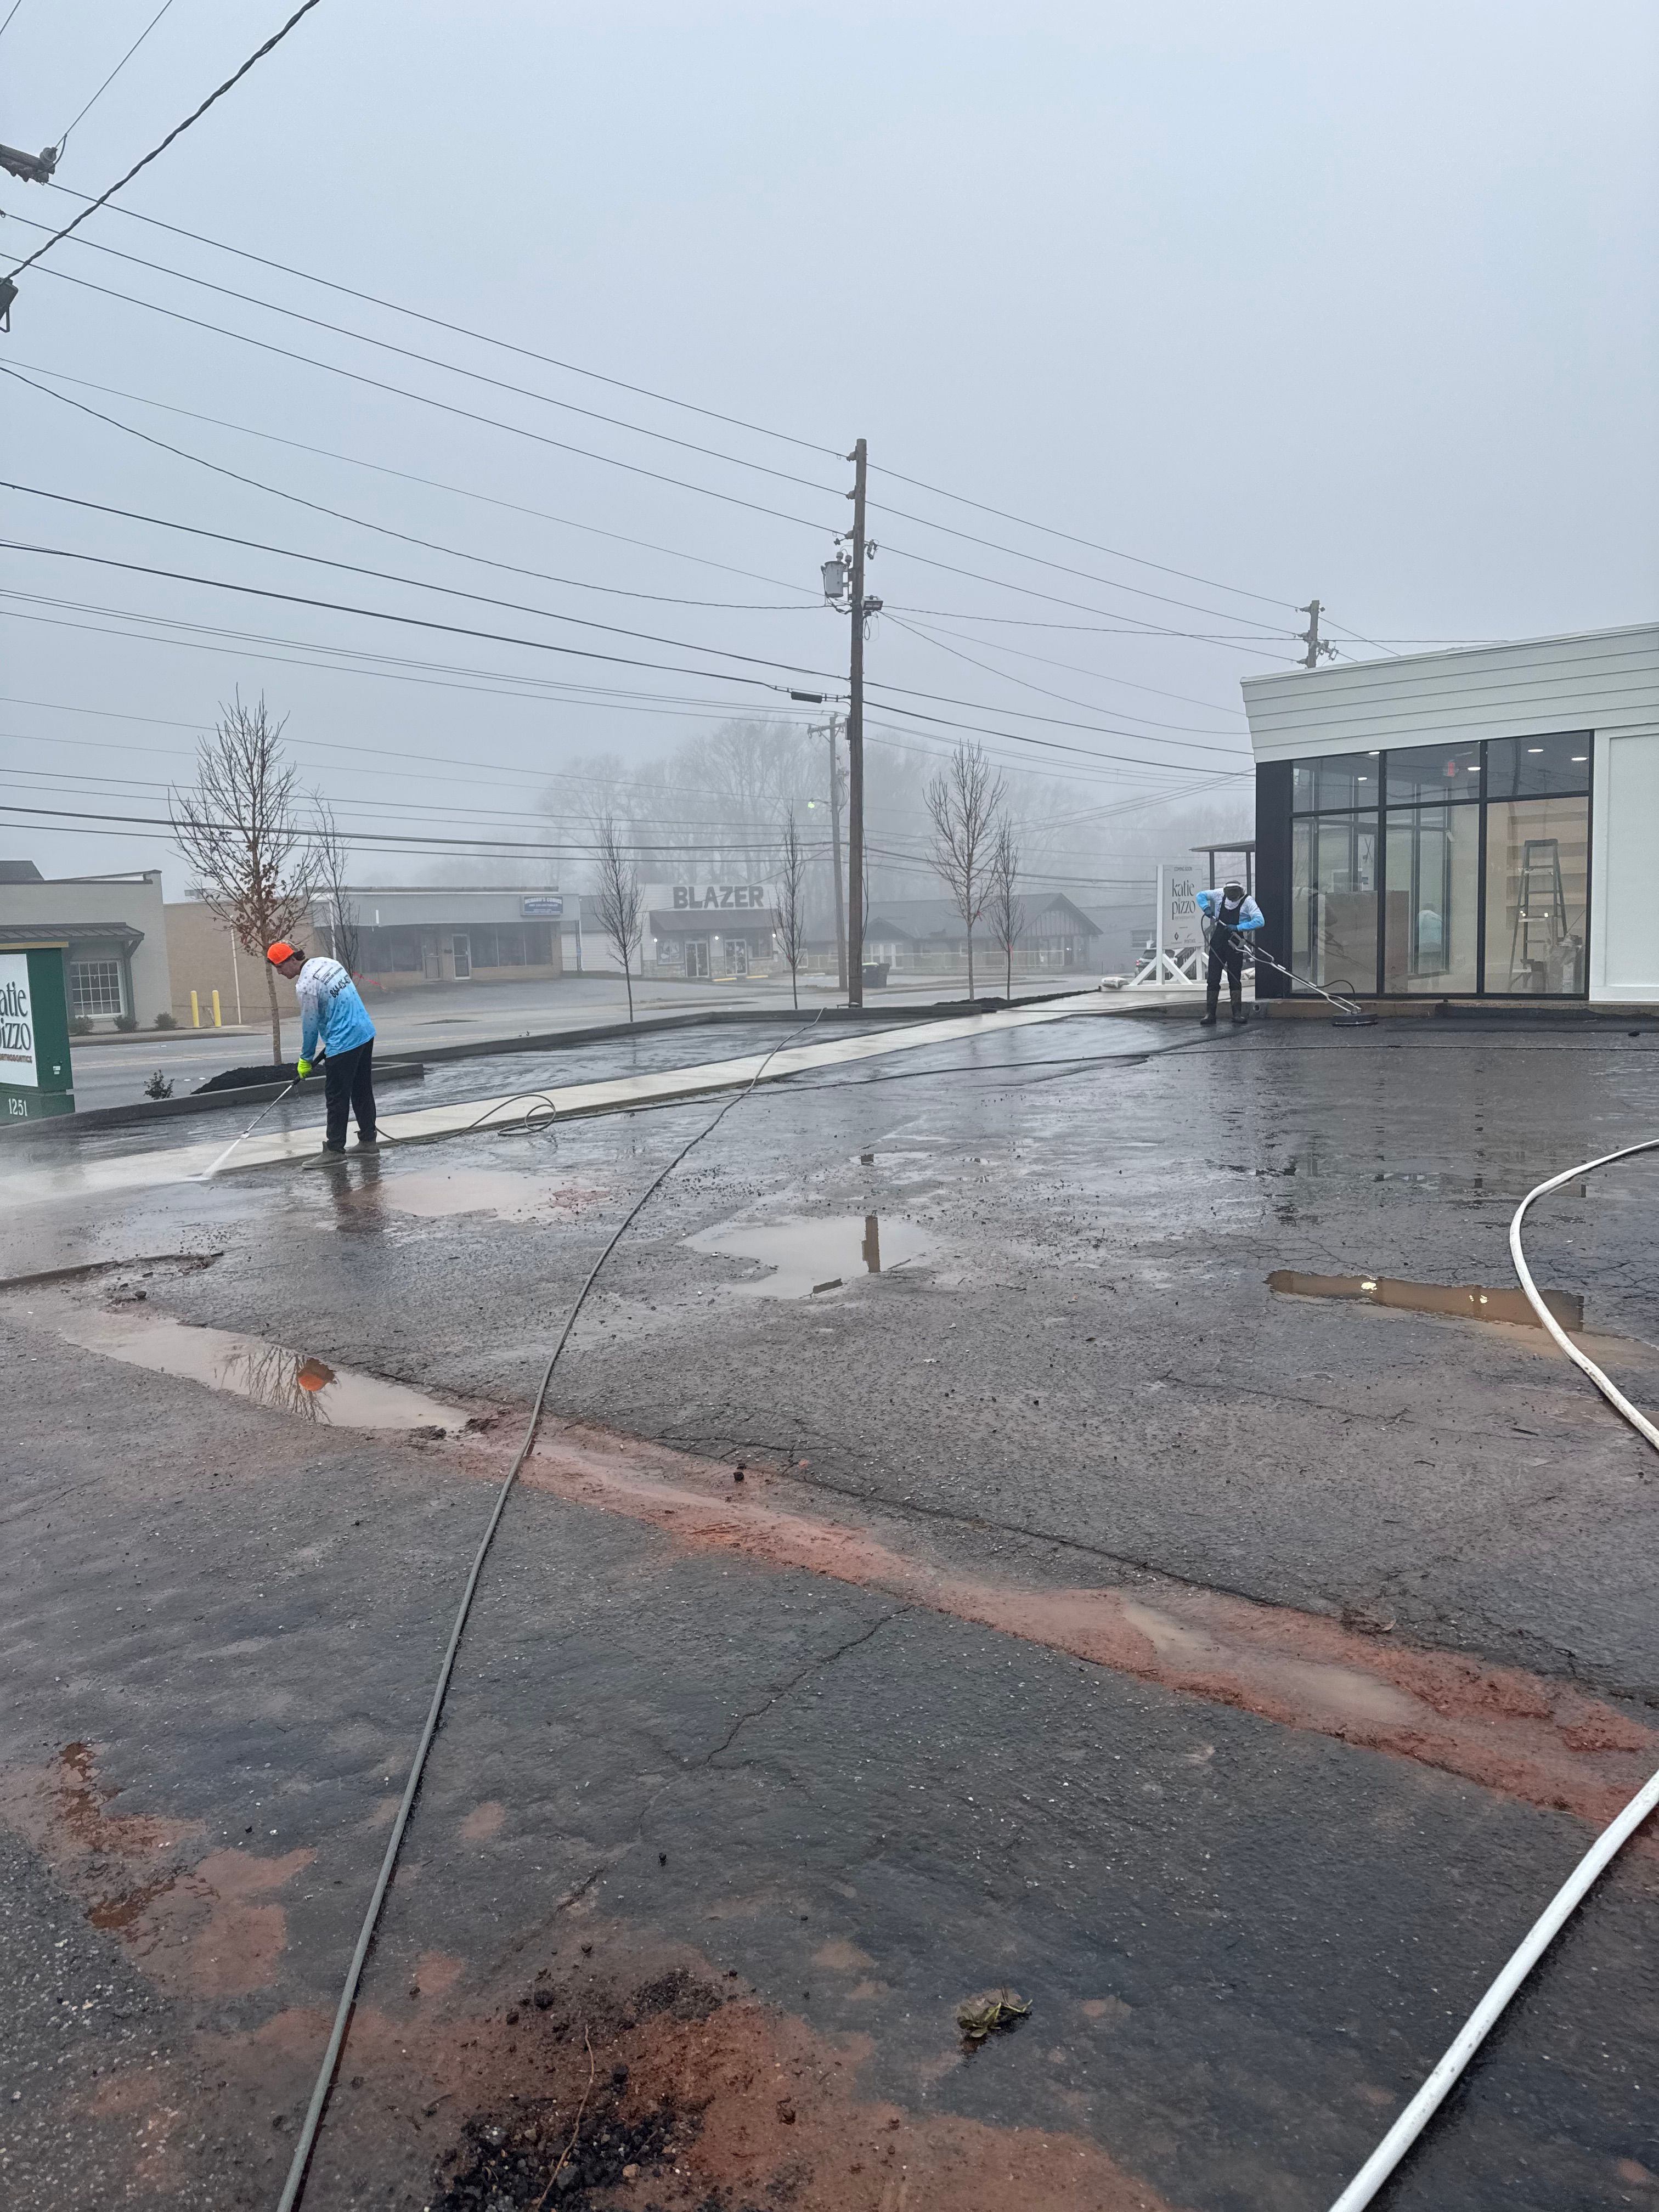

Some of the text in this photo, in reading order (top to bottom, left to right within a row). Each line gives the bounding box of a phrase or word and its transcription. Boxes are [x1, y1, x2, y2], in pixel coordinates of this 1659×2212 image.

[673, 886, 764, 909] BLAZER
[1172, 878, 1195, 897] katie
[1172, 899, 1196, 921] pizzo
[0, 981, 29, 1017] atie
[0, 1018, 32, 1050] izzo
[8, 1098, 28, 1118] 1251
